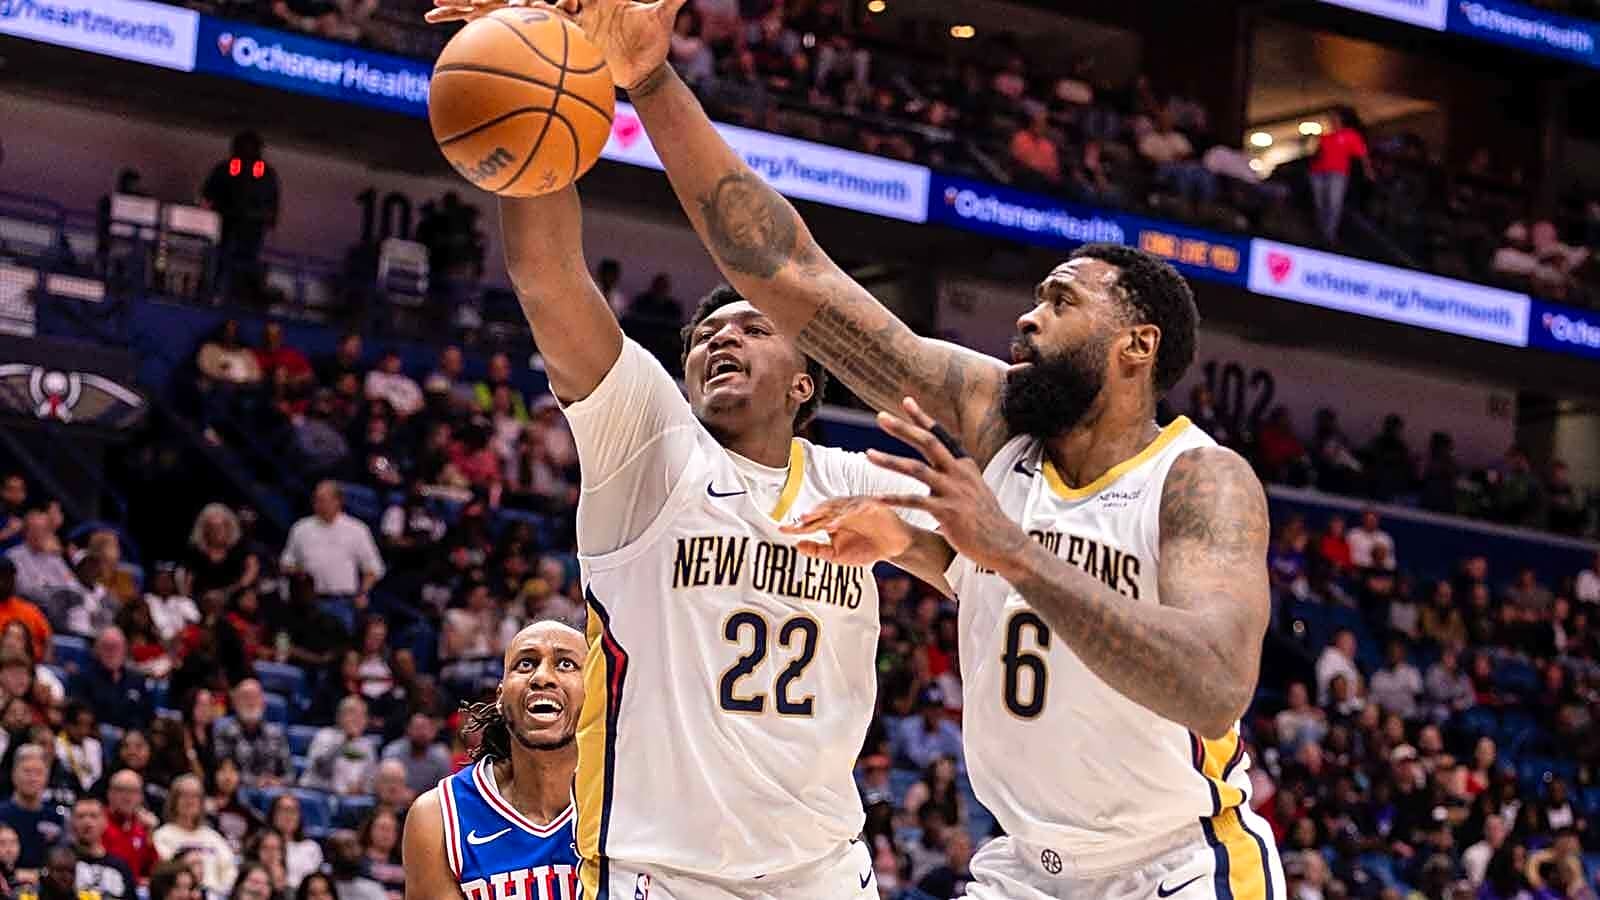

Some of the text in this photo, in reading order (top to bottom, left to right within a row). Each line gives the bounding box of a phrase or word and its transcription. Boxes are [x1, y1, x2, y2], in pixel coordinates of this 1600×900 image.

[672, 536, 864, 609] NEW ORLEANS
[719, 608, 822, 718] 22
[1000, 609, 1050, 720] 6
